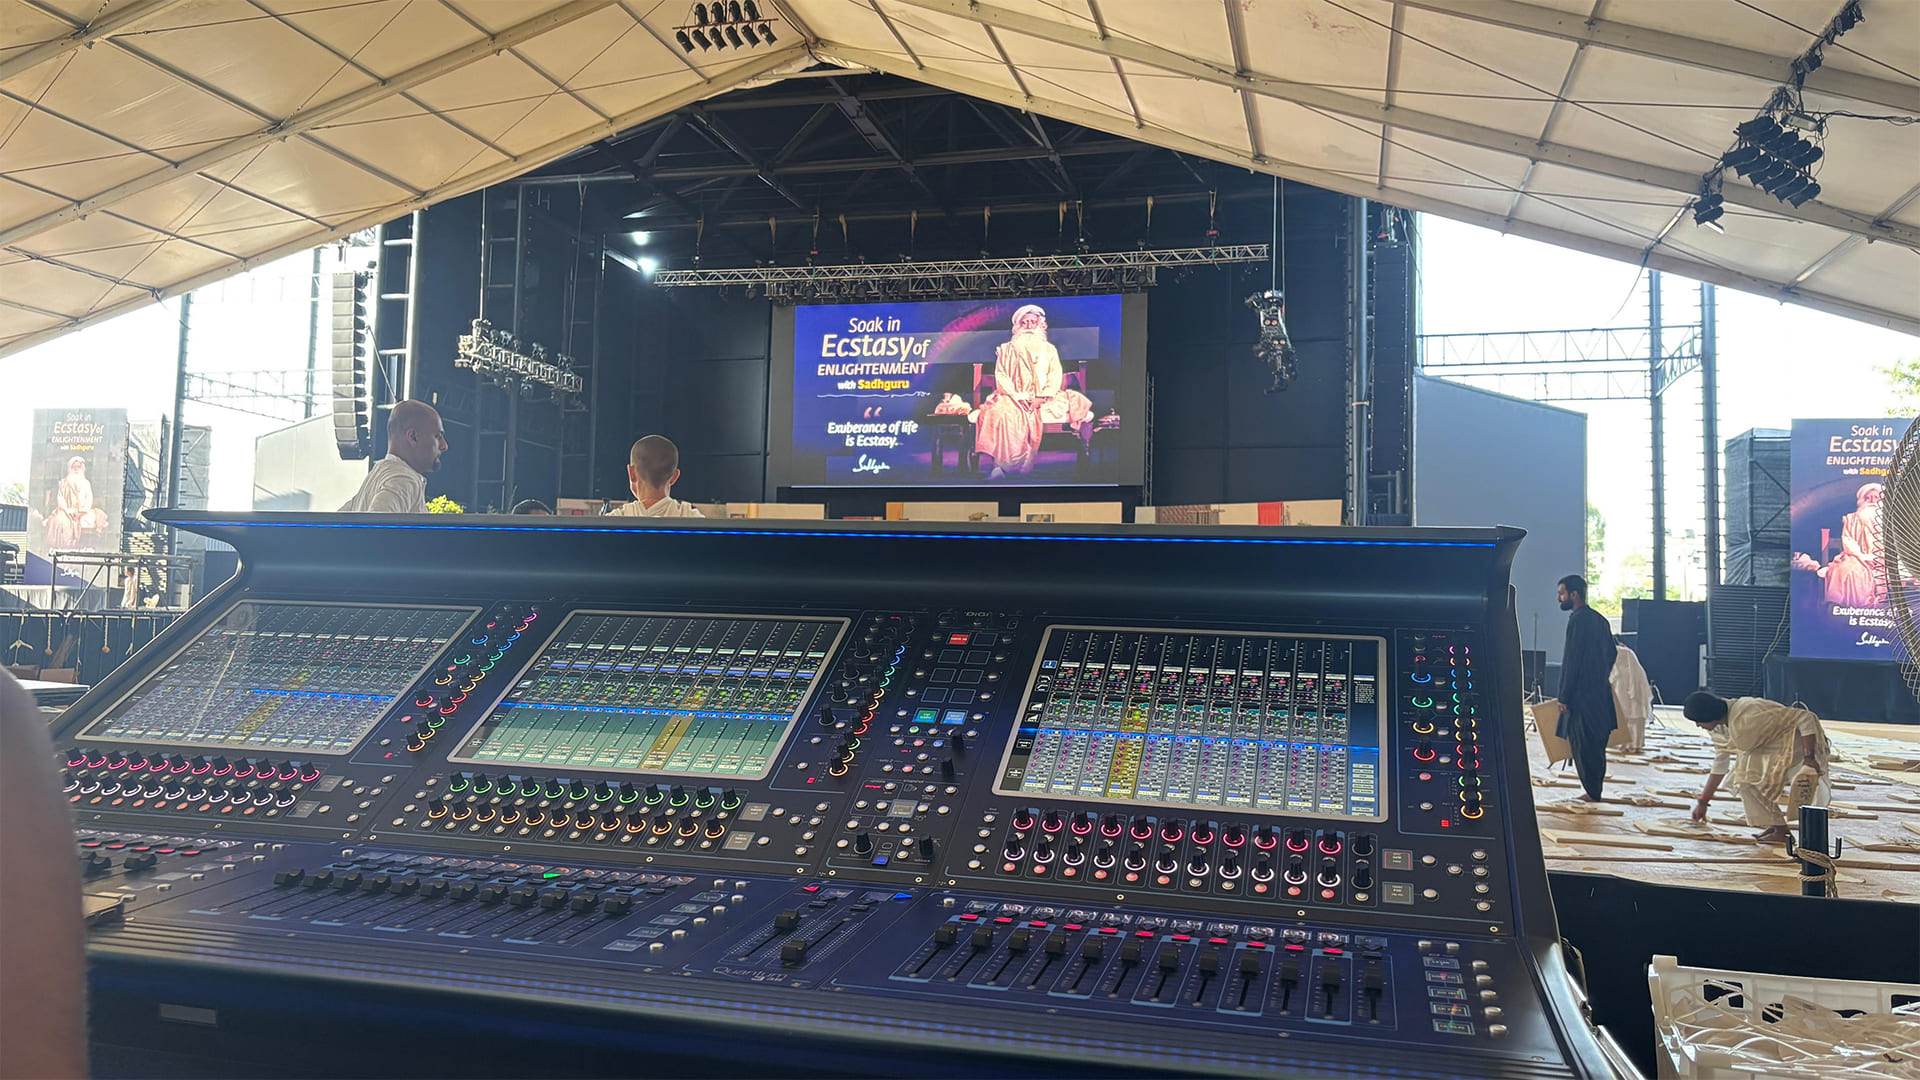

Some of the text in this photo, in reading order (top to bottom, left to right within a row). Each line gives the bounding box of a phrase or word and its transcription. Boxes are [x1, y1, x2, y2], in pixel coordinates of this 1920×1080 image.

[848, 316, 901, 333] Soak in
[821, 333, 932, 362] Ecstasy of
[817, 362, 929, 376] ENLIGHTENMENT
[837, 379, 910, 391] with Sadhguru
[66, 412, 83, 421] Soak
[53, 421, 98, 436] Ecstasy
[827, 420, 919, 436] Exuberance of life
[1851, 425, 1893, 436] Soak in
[845, 434, 899, 449] is Ecstasy.
[1832, 606, 1886, 616] Exuberance
